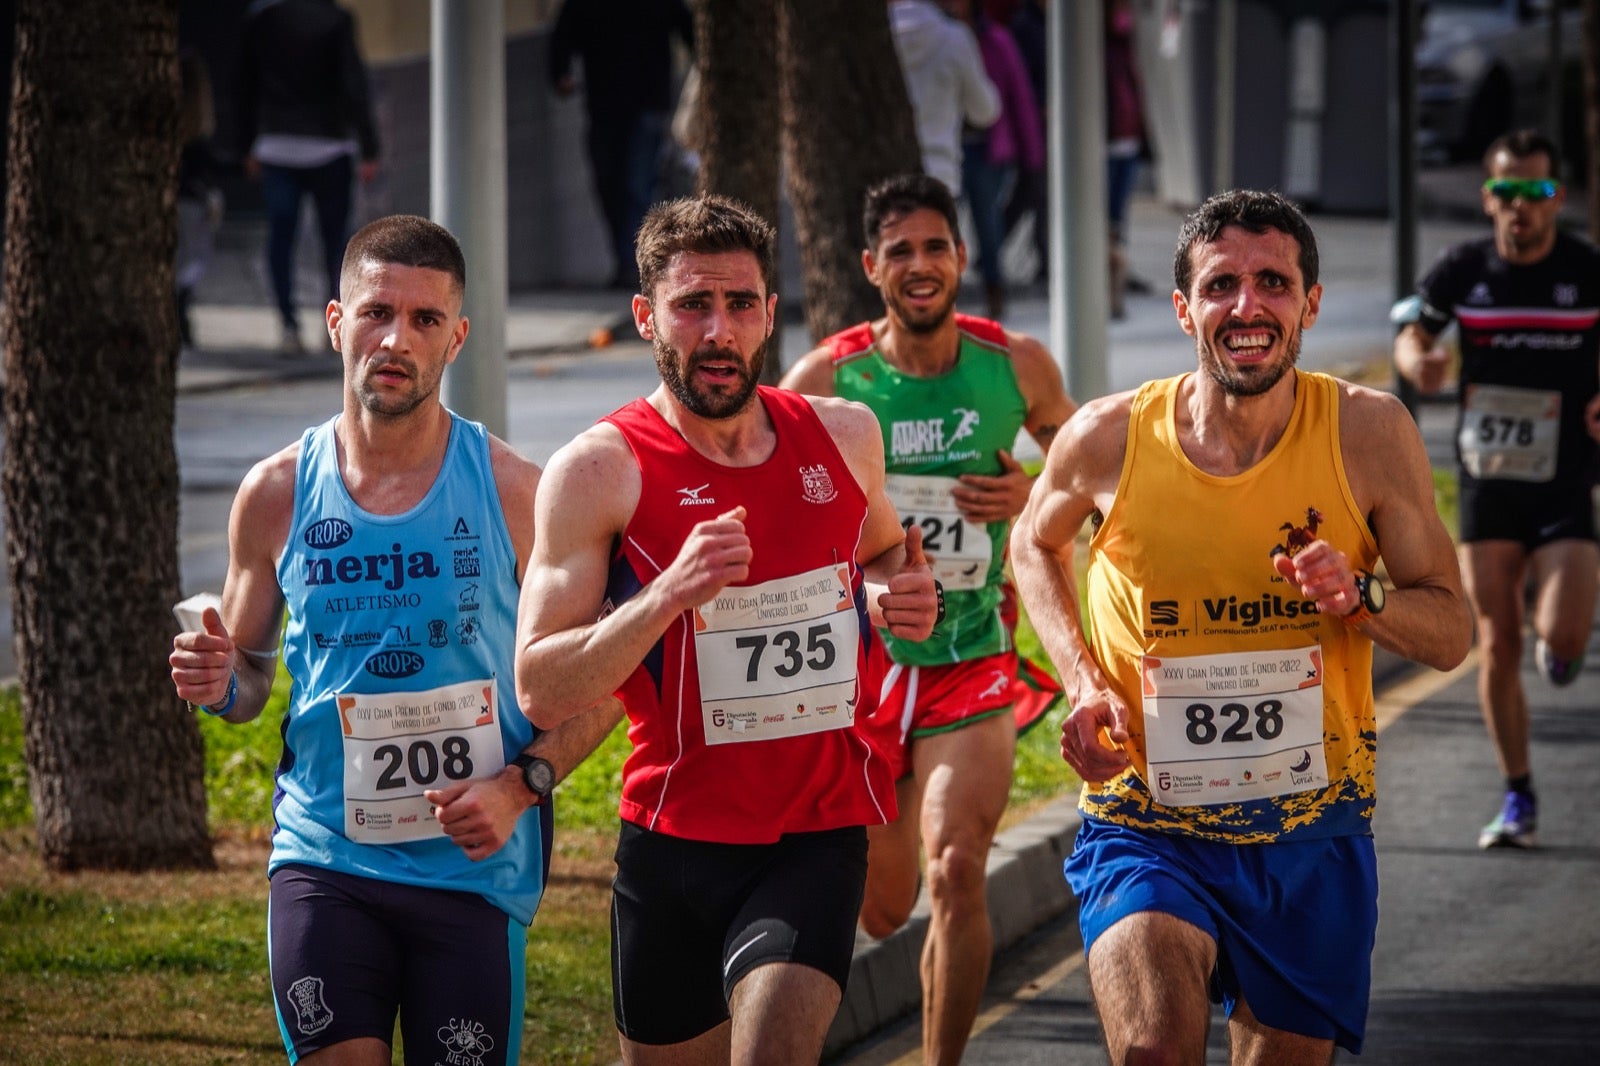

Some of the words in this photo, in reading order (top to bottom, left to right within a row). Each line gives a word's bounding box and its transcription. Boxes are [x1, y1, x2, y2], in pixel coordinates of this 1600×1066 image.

[891, 420, 945, 455] ATARFE
[1480, 415, 1534, 446] 578
[799, 464, 828, 475] C.A.B.
[307, 523, 350, 545] TROPS
[305, 543, 440, 591] nerja
[324, 593, 421, 614] ATLETISMO
[715, 598, 735, 611] XXXV
[817, 578, 832, 593] 2022
[1203, 593, 1321, 627] Vigilsa
[1144, 628, 1190, 639] SEAT
[1260, 624, 1278, 633] SEAT
[367, 652, 422, 673] TROPS
[736, 622, 836, 683] 735
[1163, 667, 1184, 680] XXXV
[1280, 659, 1301, 673] 2022
[457, 694, 475, 709] 2022
[1185, 700, 1284, 745] 828
[373, 736, 474, 791] 208
[302, 1015, 330, 1030] ATLETISMO
[449, 1017, 484, 1033] CMD
